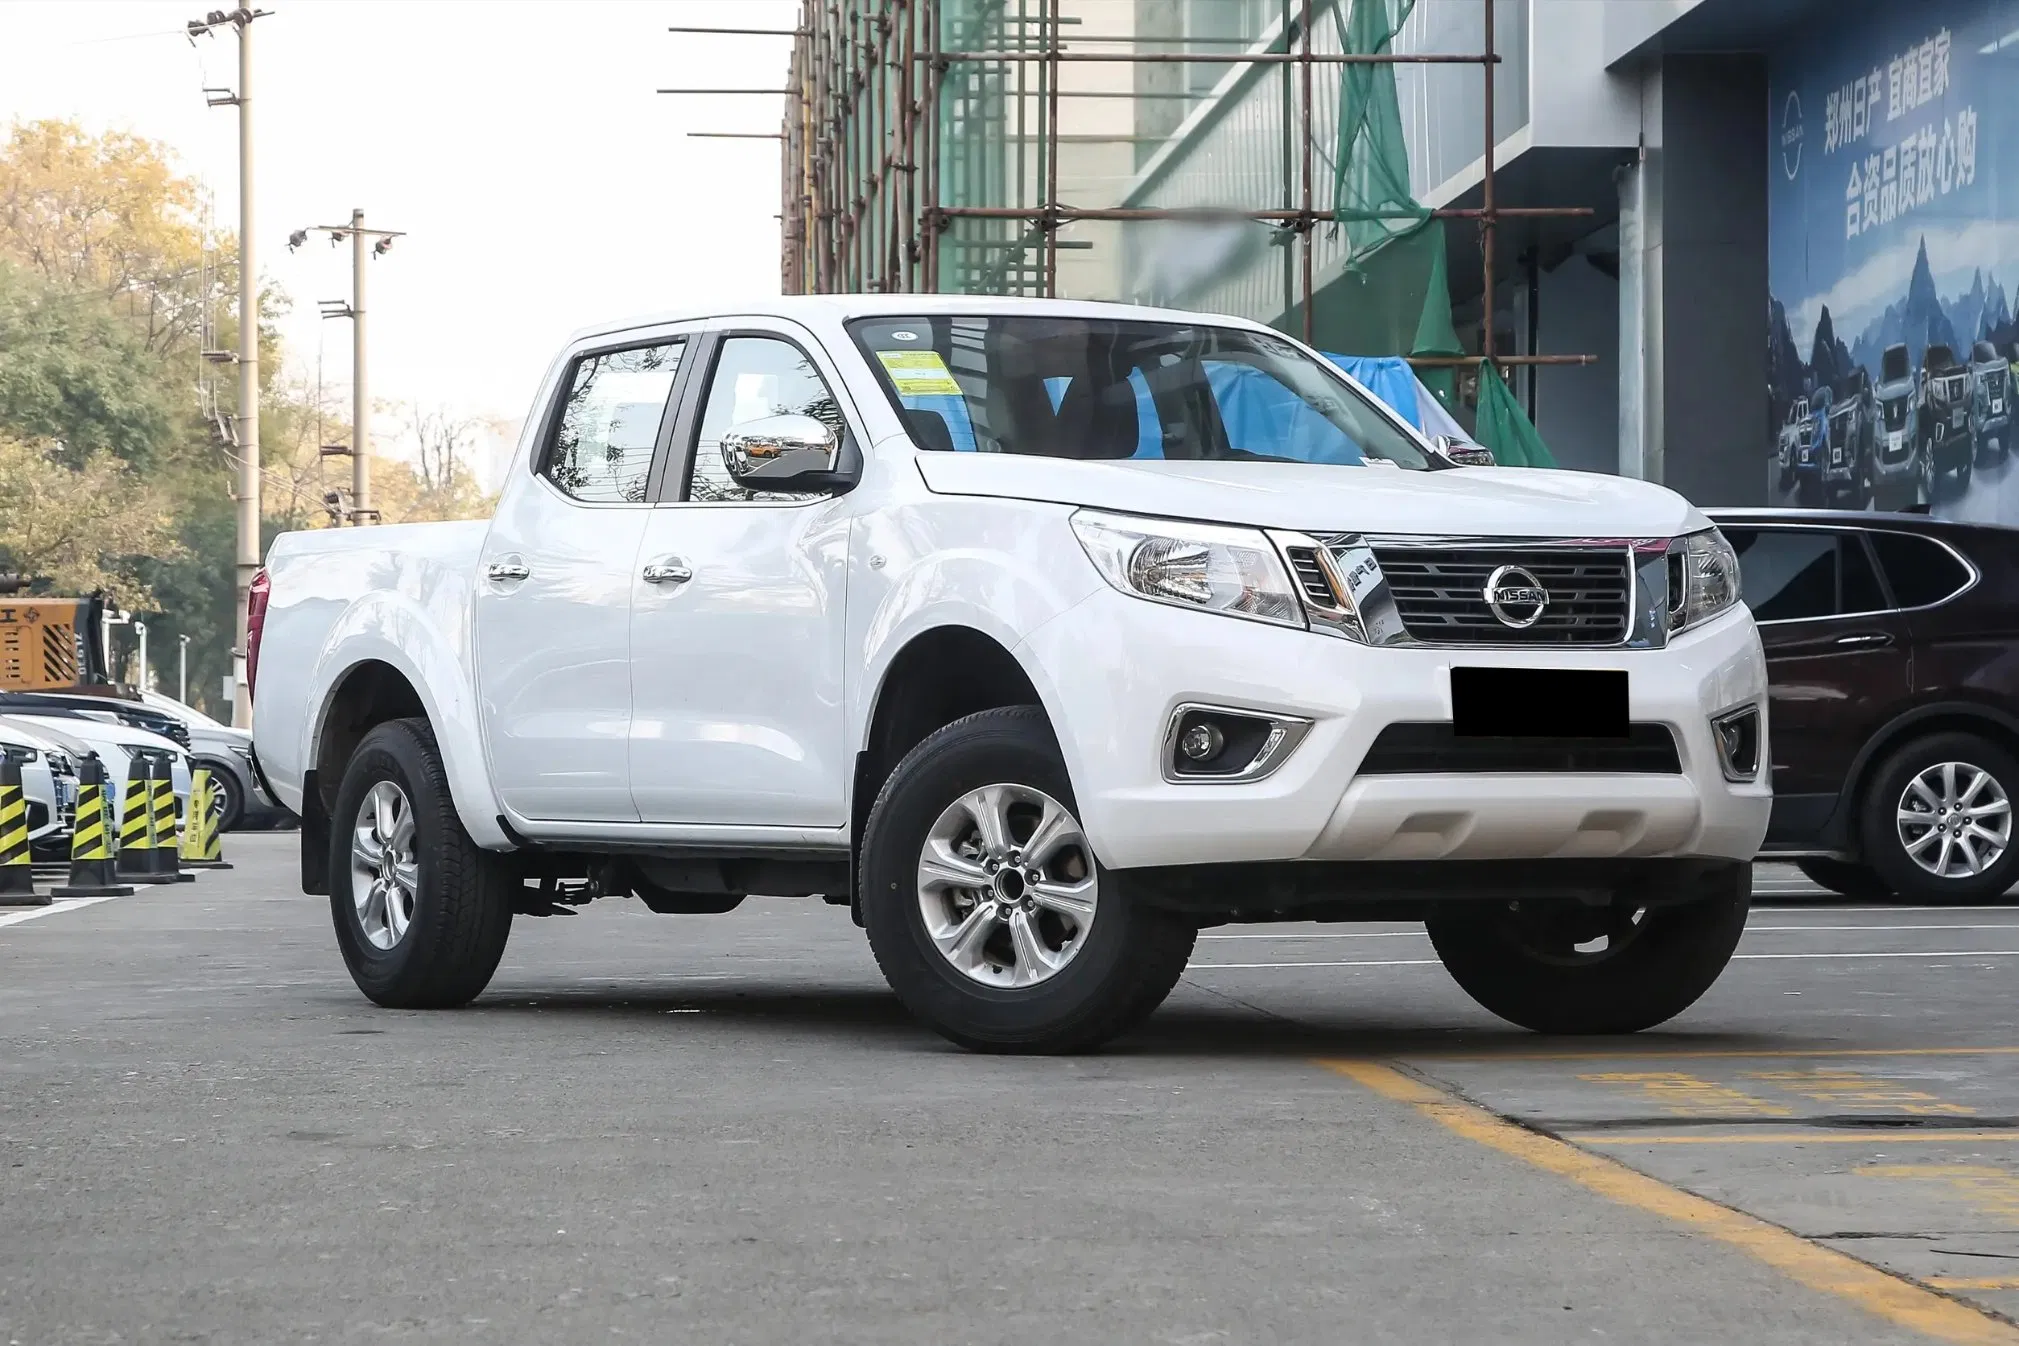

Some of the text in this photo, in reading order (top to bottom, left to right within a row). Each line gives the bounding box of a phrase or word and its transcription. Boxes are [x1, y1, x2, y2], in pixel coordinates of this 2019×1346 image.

[1824, 28, 1951, 155] 郑州日产 宜商宜家
[1846, 104, 1977, 240] 合资品质放心购
[1493, 590, 1545, 602] NISSAN
